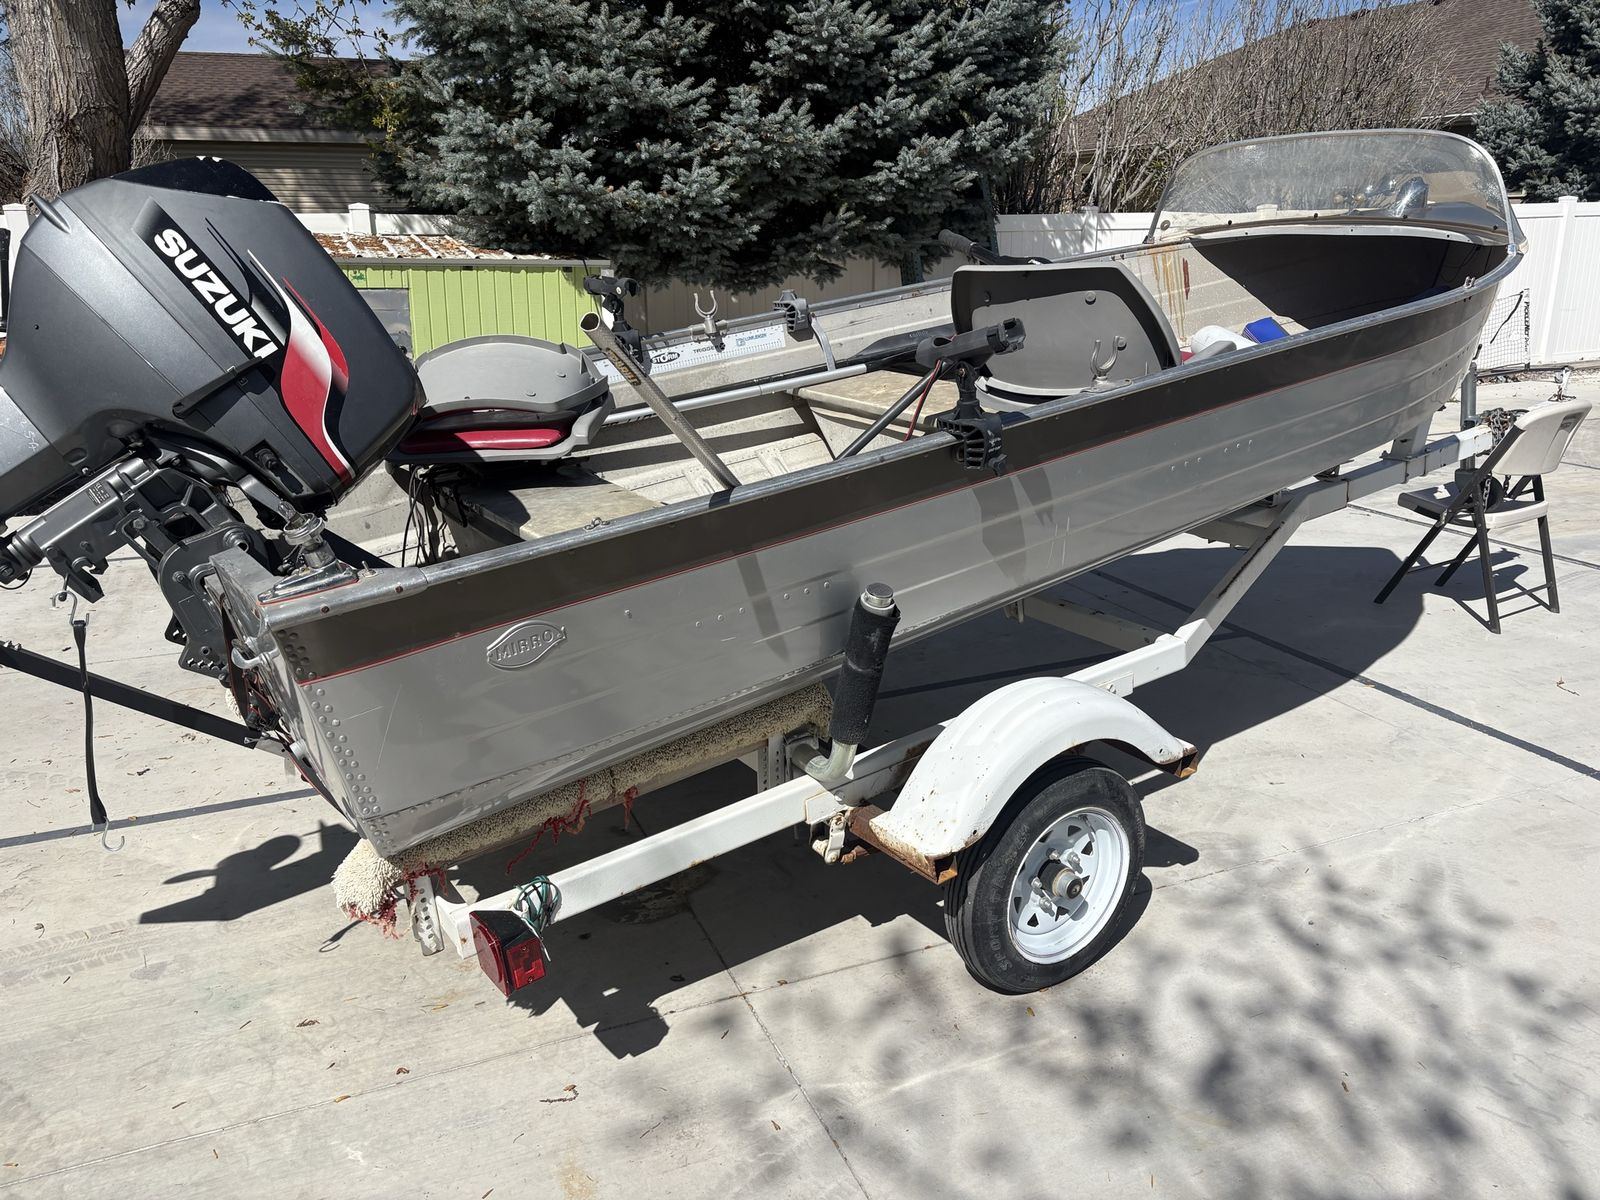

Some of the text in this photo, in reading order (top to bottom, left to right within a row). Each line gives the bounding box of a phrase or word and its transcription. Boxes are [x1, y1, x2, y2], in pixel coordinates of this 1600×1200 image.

[154, 229, 278, 358] SUZUKI
[652, 351, 678, 363] STORM
[693, 345, 717, 353] TRIGGE
[496, 630, 554, 661] MIRRO
